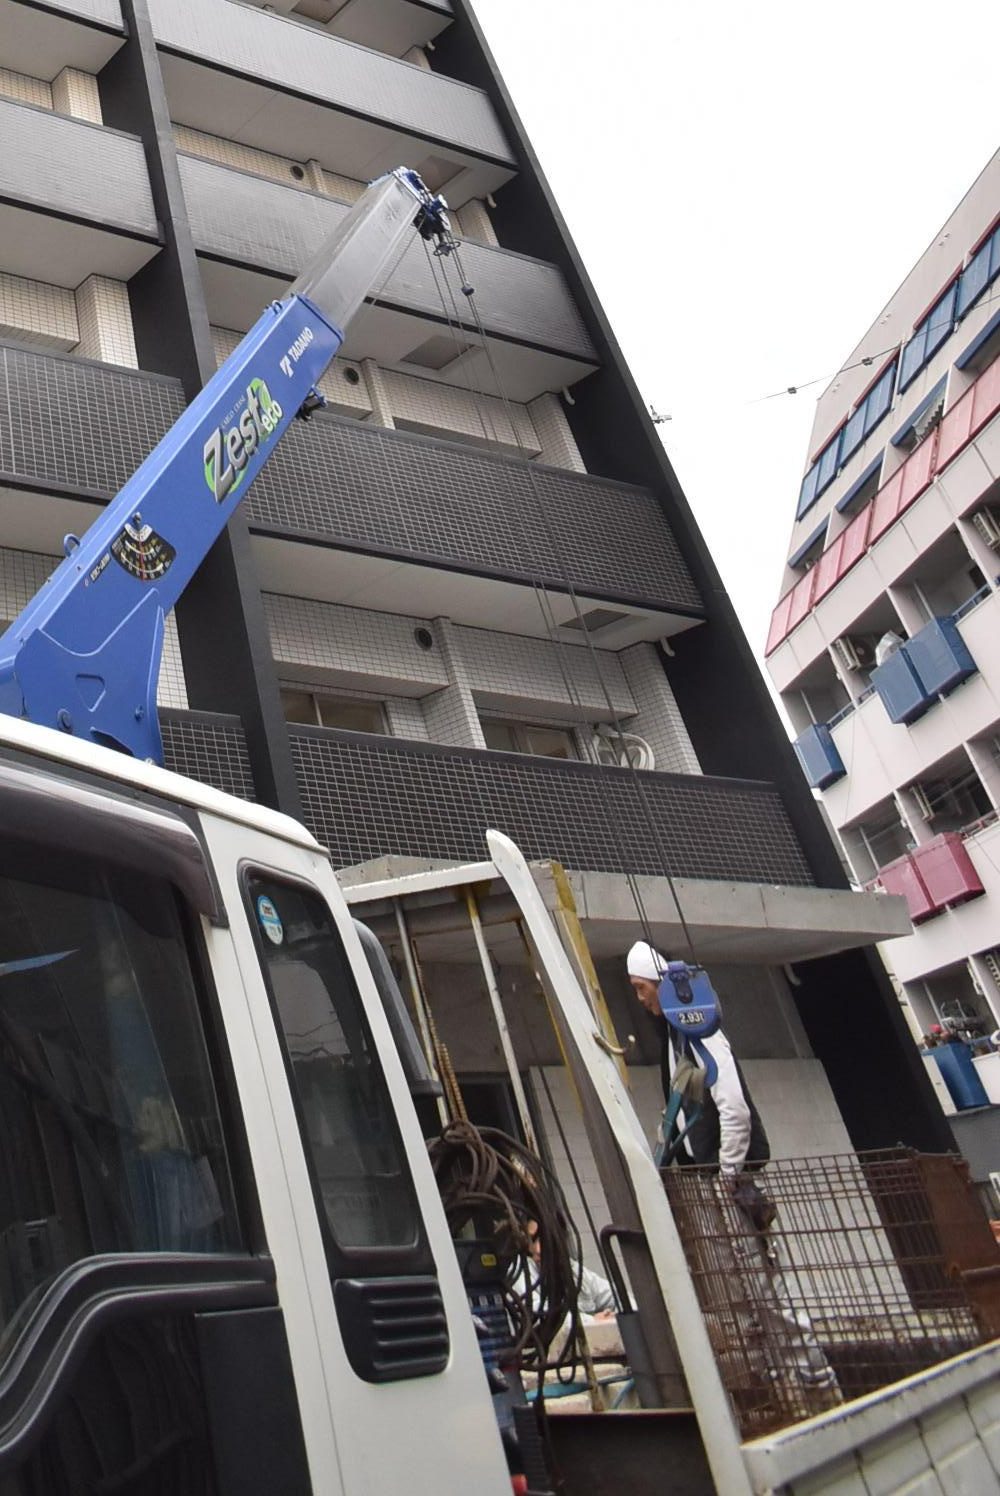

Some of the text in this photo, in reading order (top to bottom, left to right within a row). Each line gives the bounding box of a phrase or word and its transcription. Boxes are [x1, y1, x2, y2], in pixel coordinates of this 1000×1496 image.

[287, 326, 314, 363] TADANO
[261, 399, 283, 432] eco
[203, 384, 266, 504] Zest
